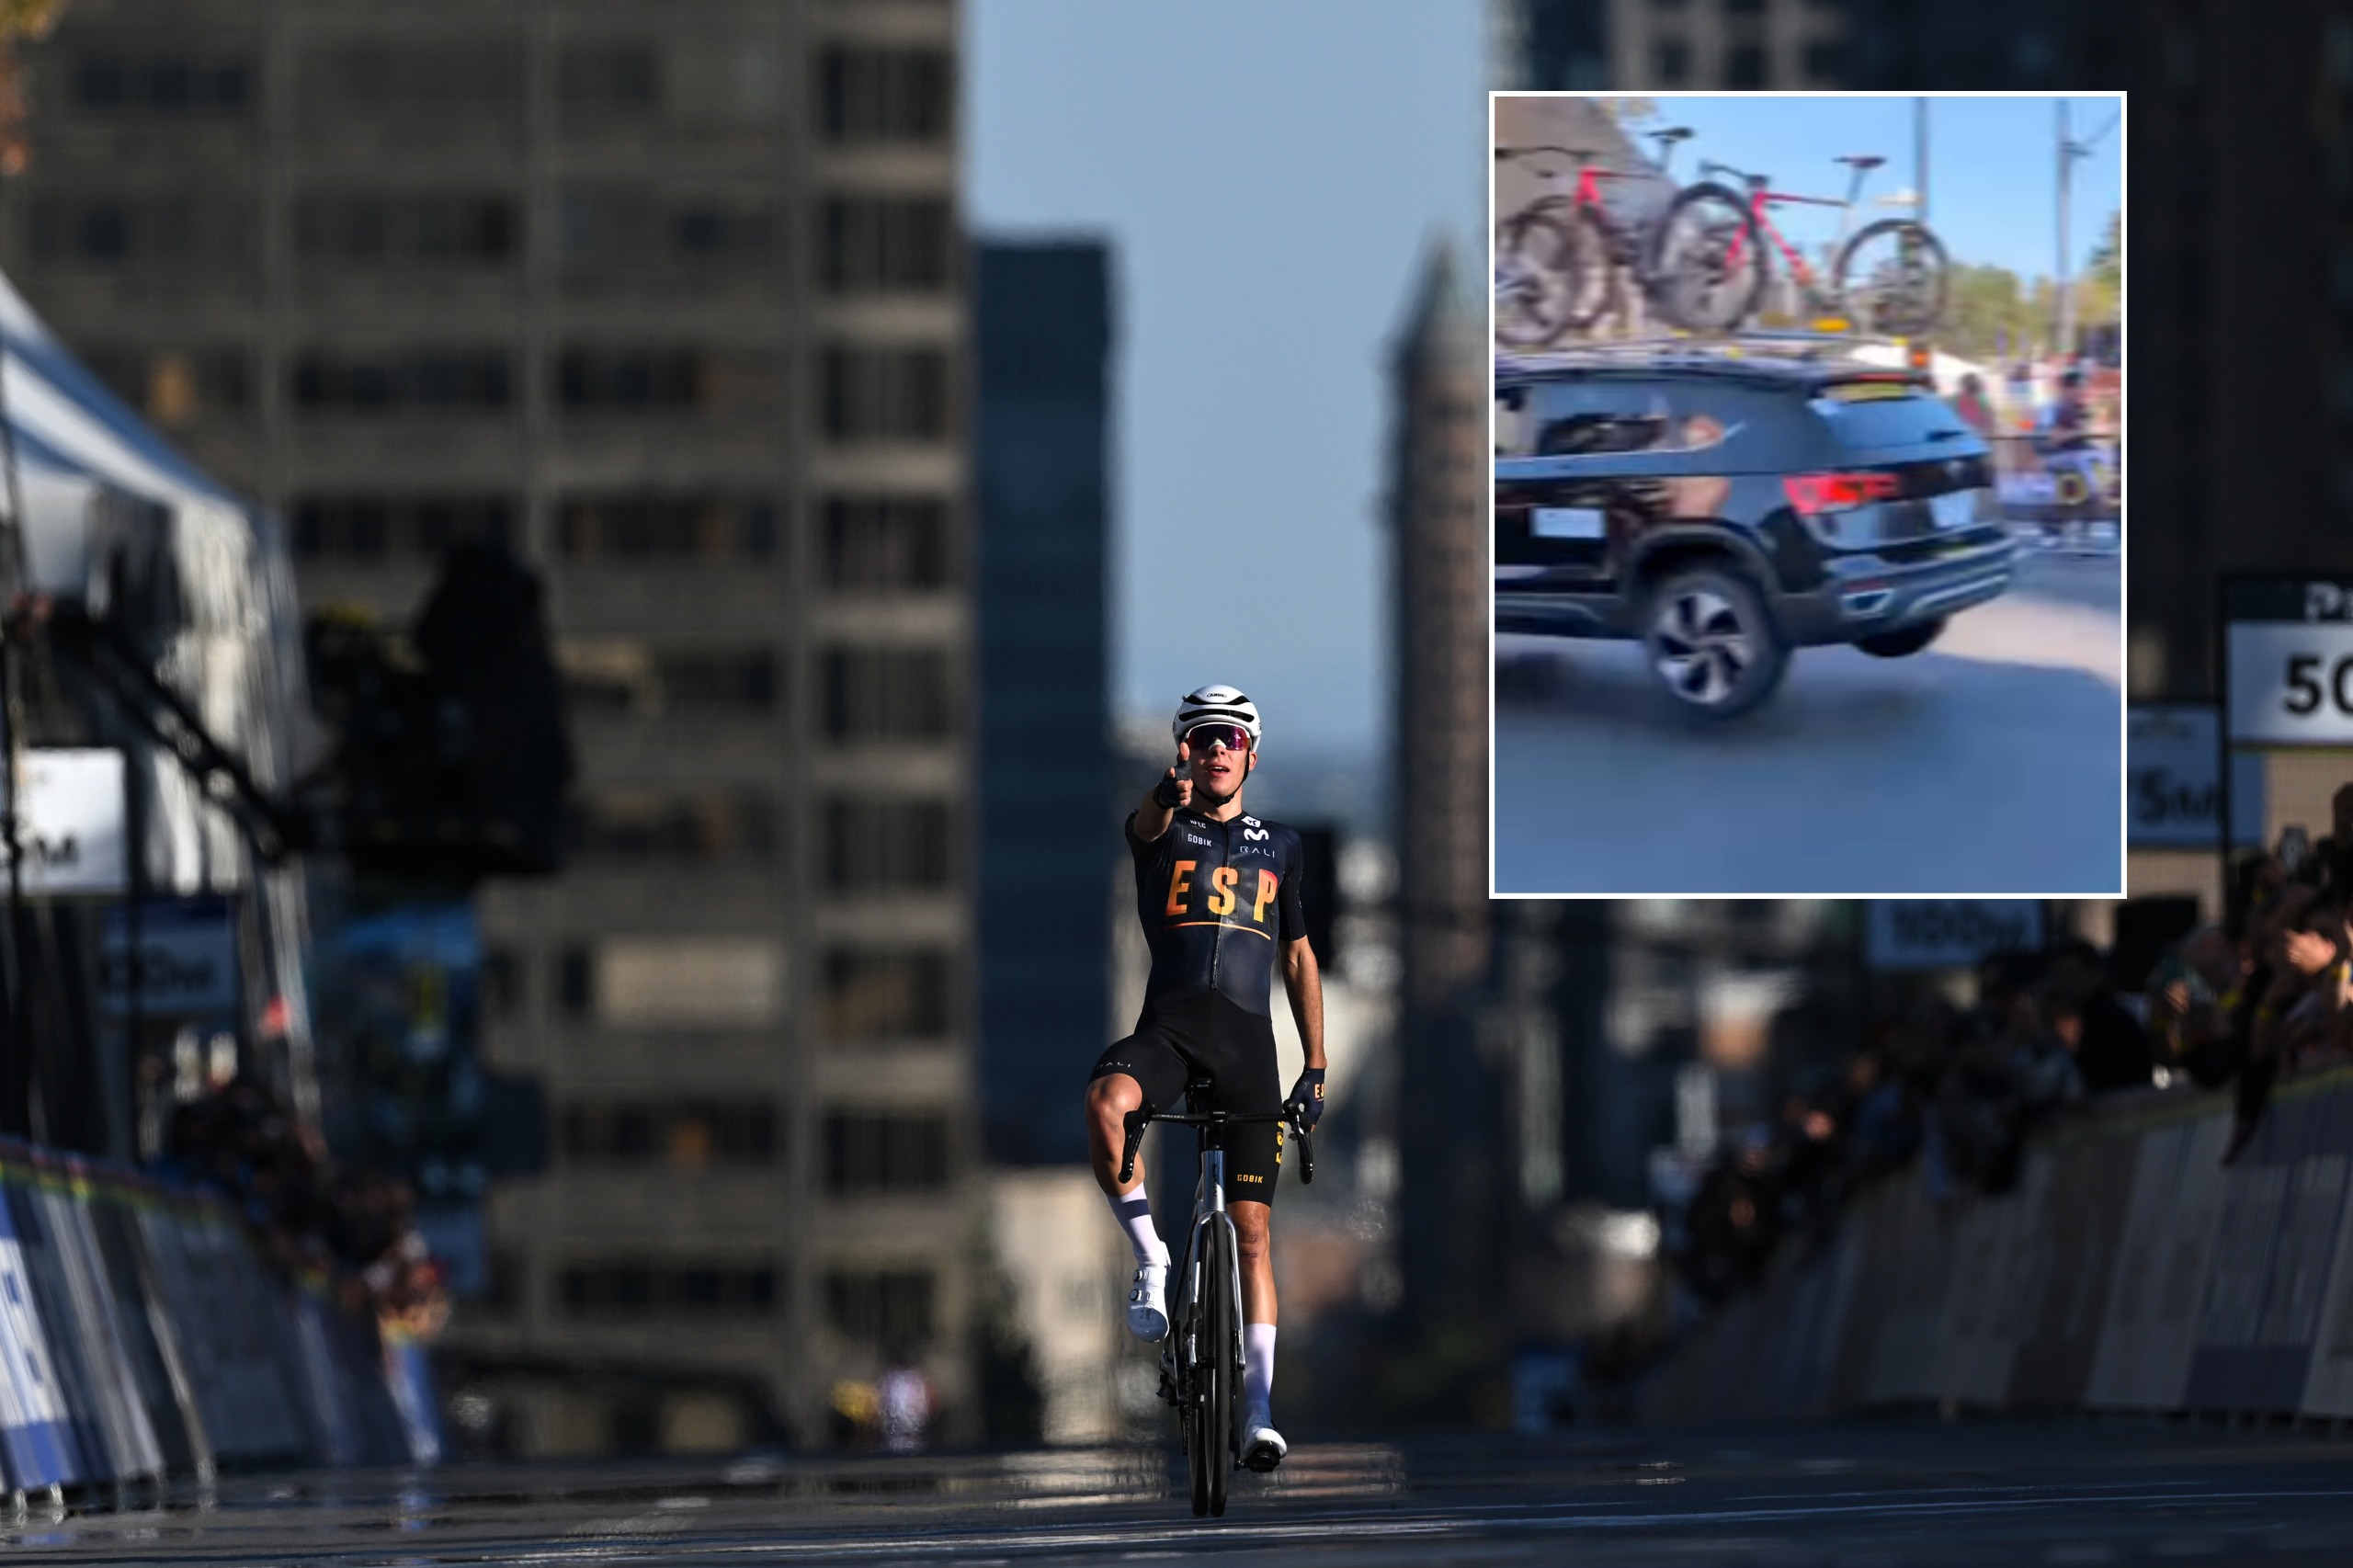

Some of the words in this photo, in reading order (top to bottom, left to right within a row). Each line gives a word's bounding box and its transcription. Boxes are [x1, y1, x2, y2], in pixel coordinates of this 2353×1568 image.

[1188, 834, 1212, 847] GOBIK
[1165, 859, 1279, 923] ESP
[1237, 1174, 1264, 1184] GOBIK
